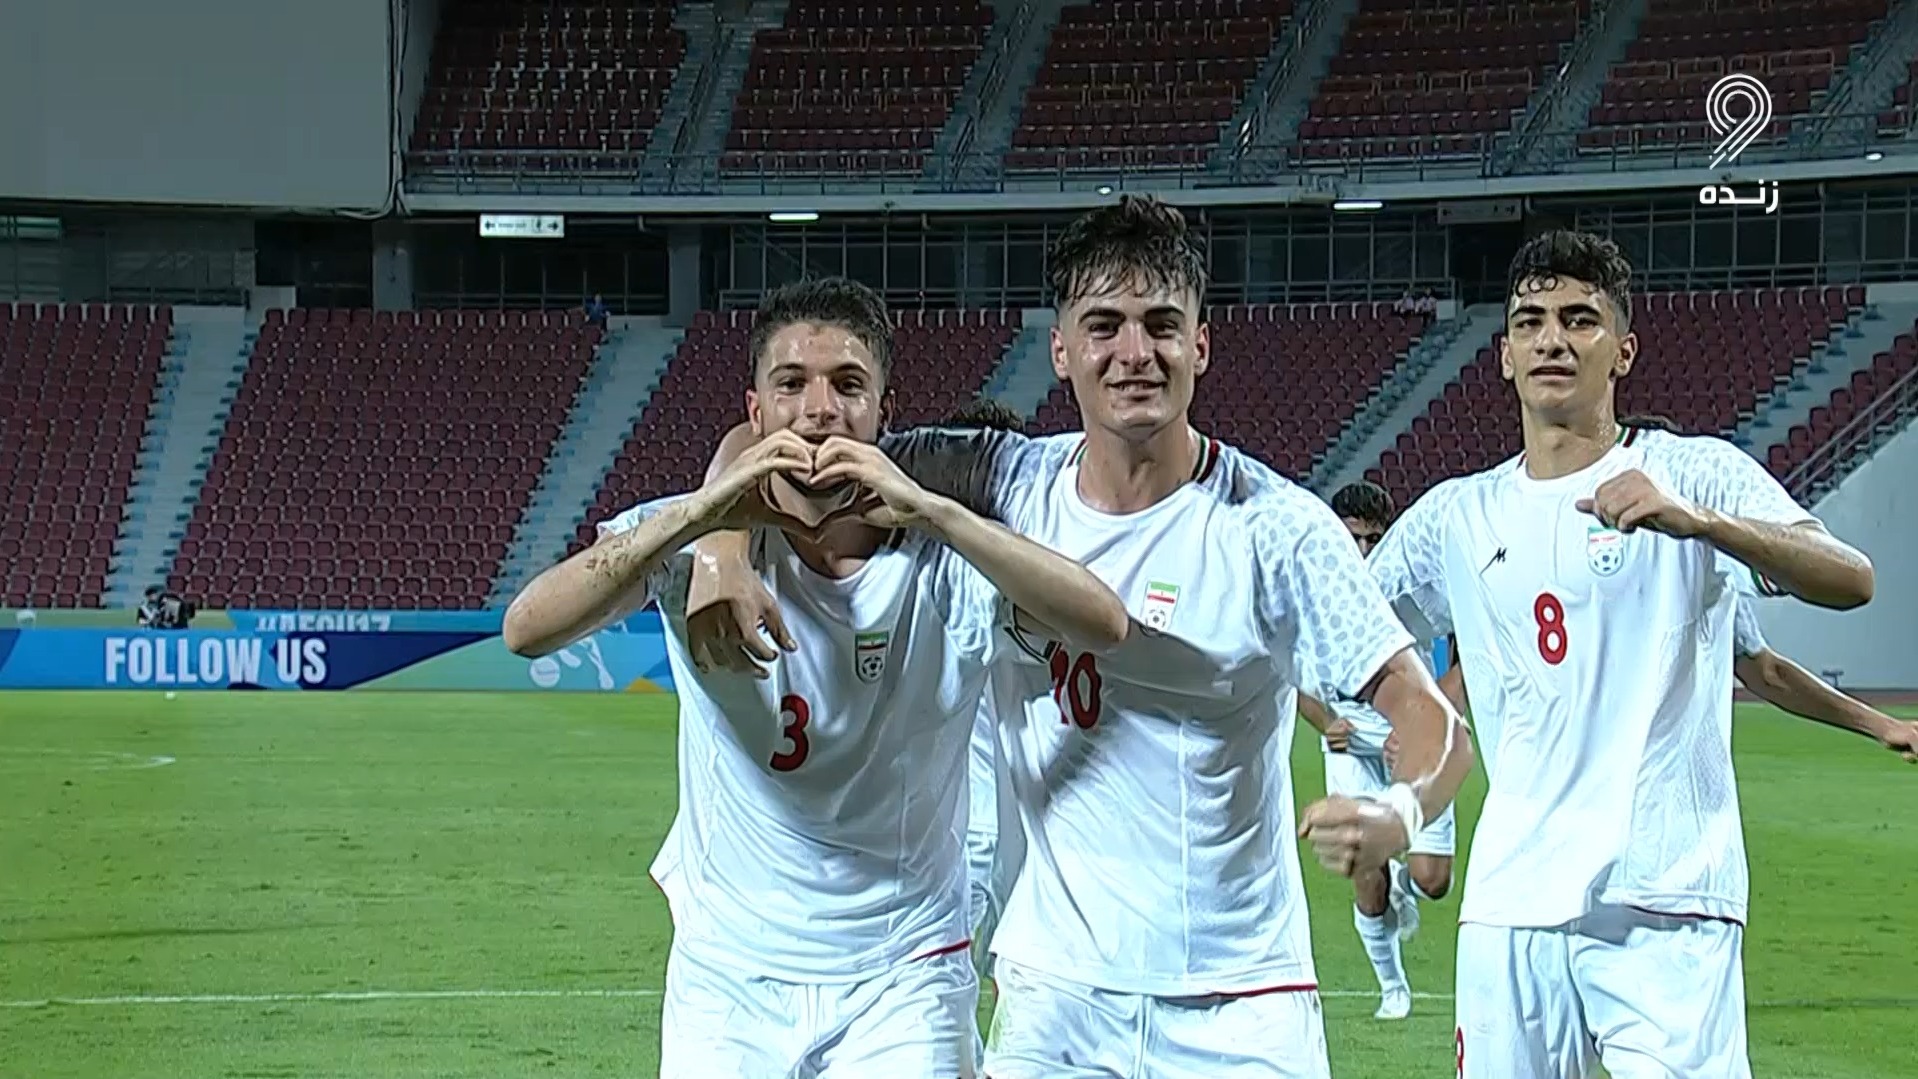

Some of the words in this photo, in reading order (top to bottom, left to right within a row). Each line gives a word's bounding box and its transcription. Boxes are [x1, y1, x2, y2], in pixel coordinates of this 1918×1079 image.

[105, 637, 262, 683] FOLLOW
[276, 637, 327, 684] US
[1534, 592, 1568, 665] 8
[770, 693, 810, 772] 3
